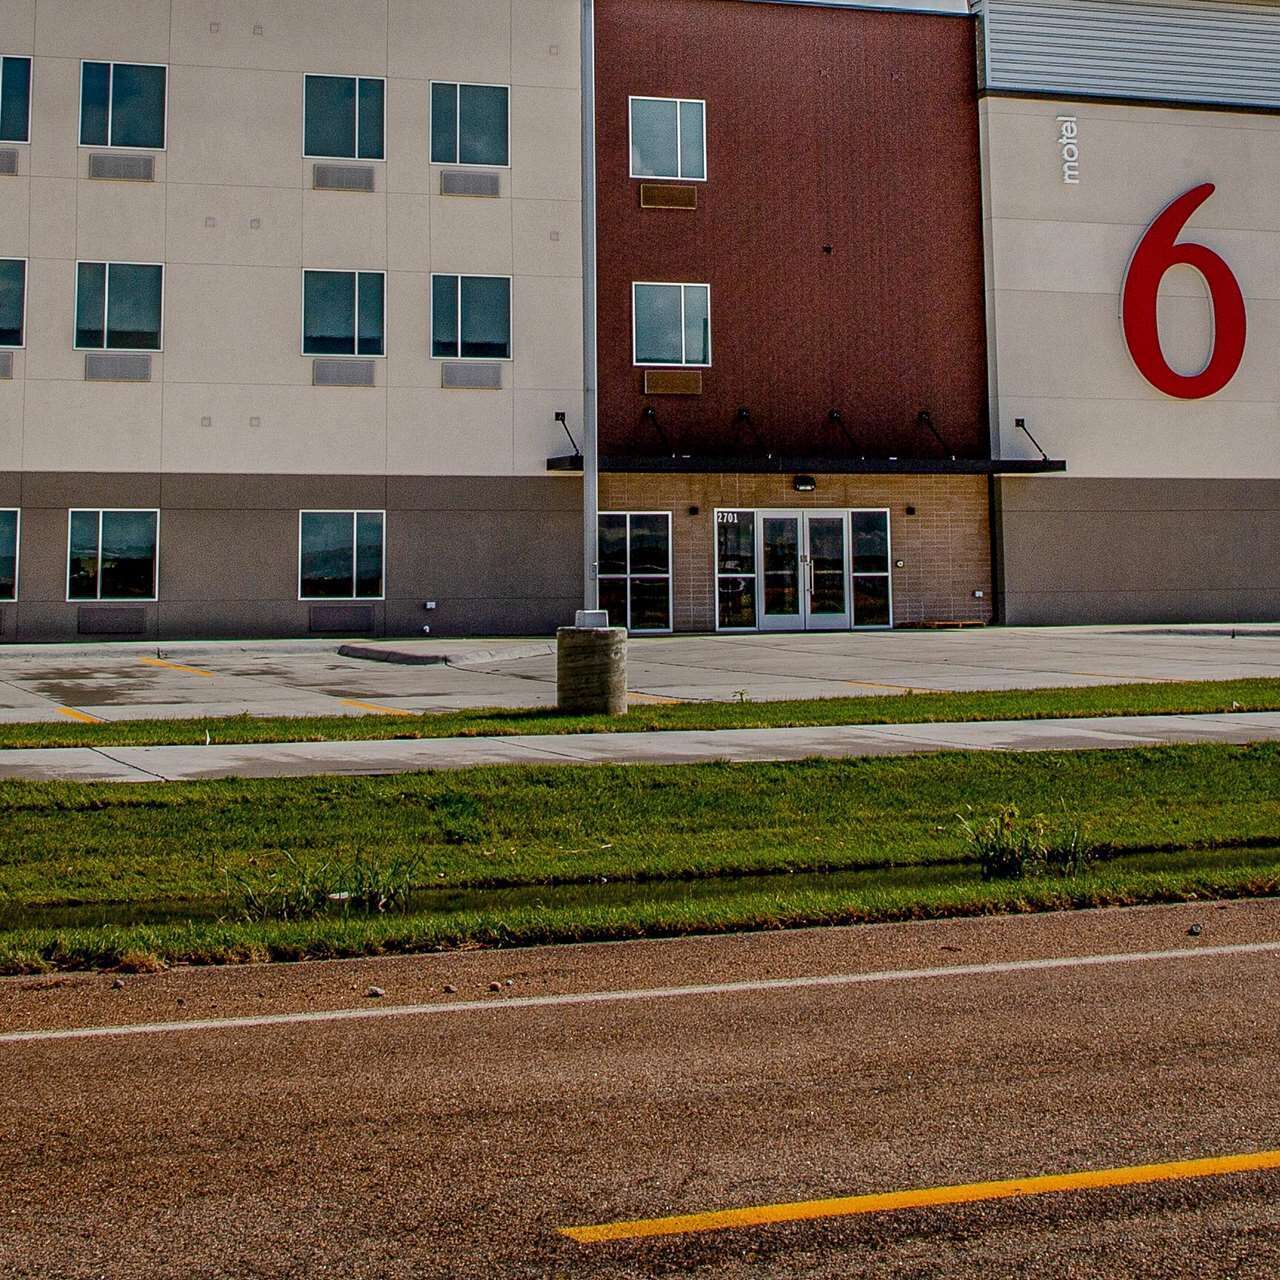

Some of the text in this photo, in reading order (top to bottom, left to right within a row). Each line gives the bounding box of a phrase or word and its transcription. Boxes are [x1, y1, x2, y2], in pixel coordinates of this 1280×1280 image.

[1056, 116, 1080, 184] motel
[1122, 182, 1247, 400] 6
[717, 512, 738, 523] 2701
